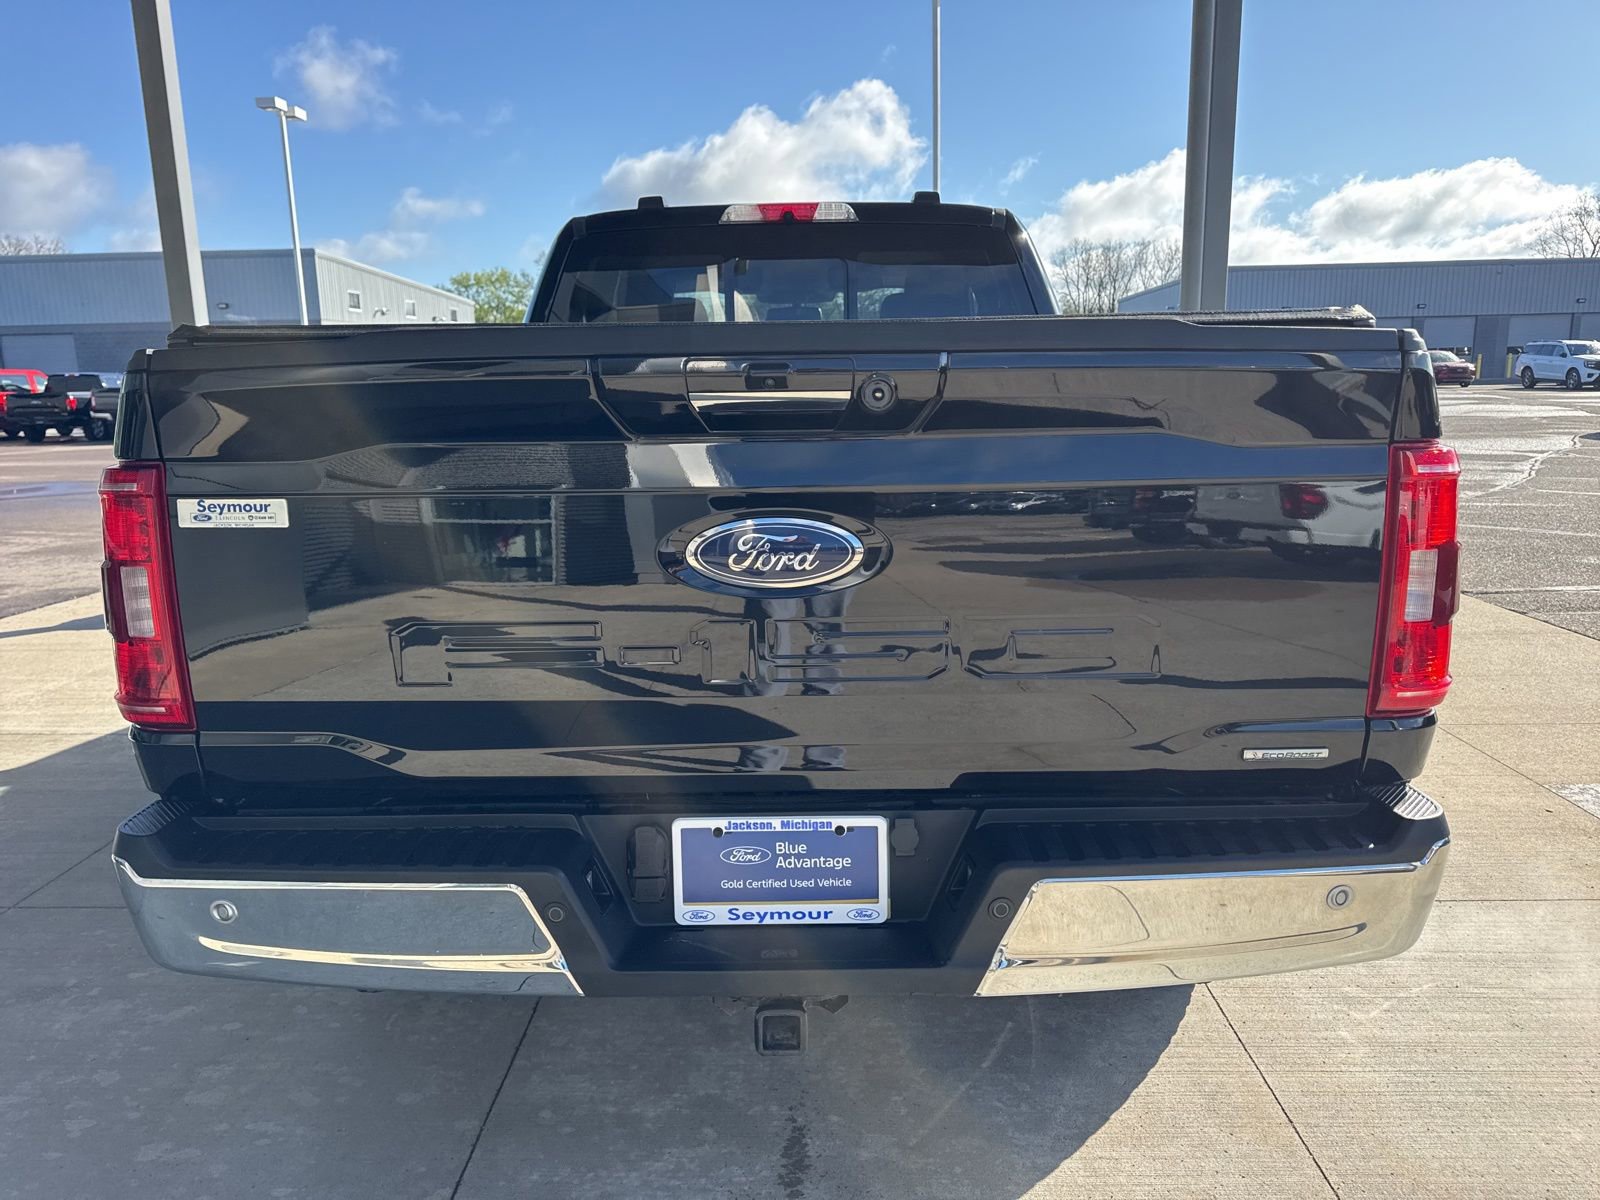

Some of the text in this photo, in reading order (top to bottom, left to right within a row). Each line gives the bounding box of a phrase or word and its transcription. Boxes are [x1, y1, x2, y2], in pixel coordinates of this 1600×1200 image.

[196, 499, 271, 515] Seymour
[728, 533, 822, 572] Ford
[391, 613, 1162, 686] F-150
[724, 819, 833, 831] Jackson, Michigan
[776, 841, 807, 854] Blue
[730, 848, 762, 862] Ford
[776, 855, 852, 870] Advantage
[720, 877, 852, 889] Gold Certified Used Vehicle
[689, 911, 709, 921] Ford
[727, 907, 833, 923] Seymour
[853, 909, 873, 919] Ford
